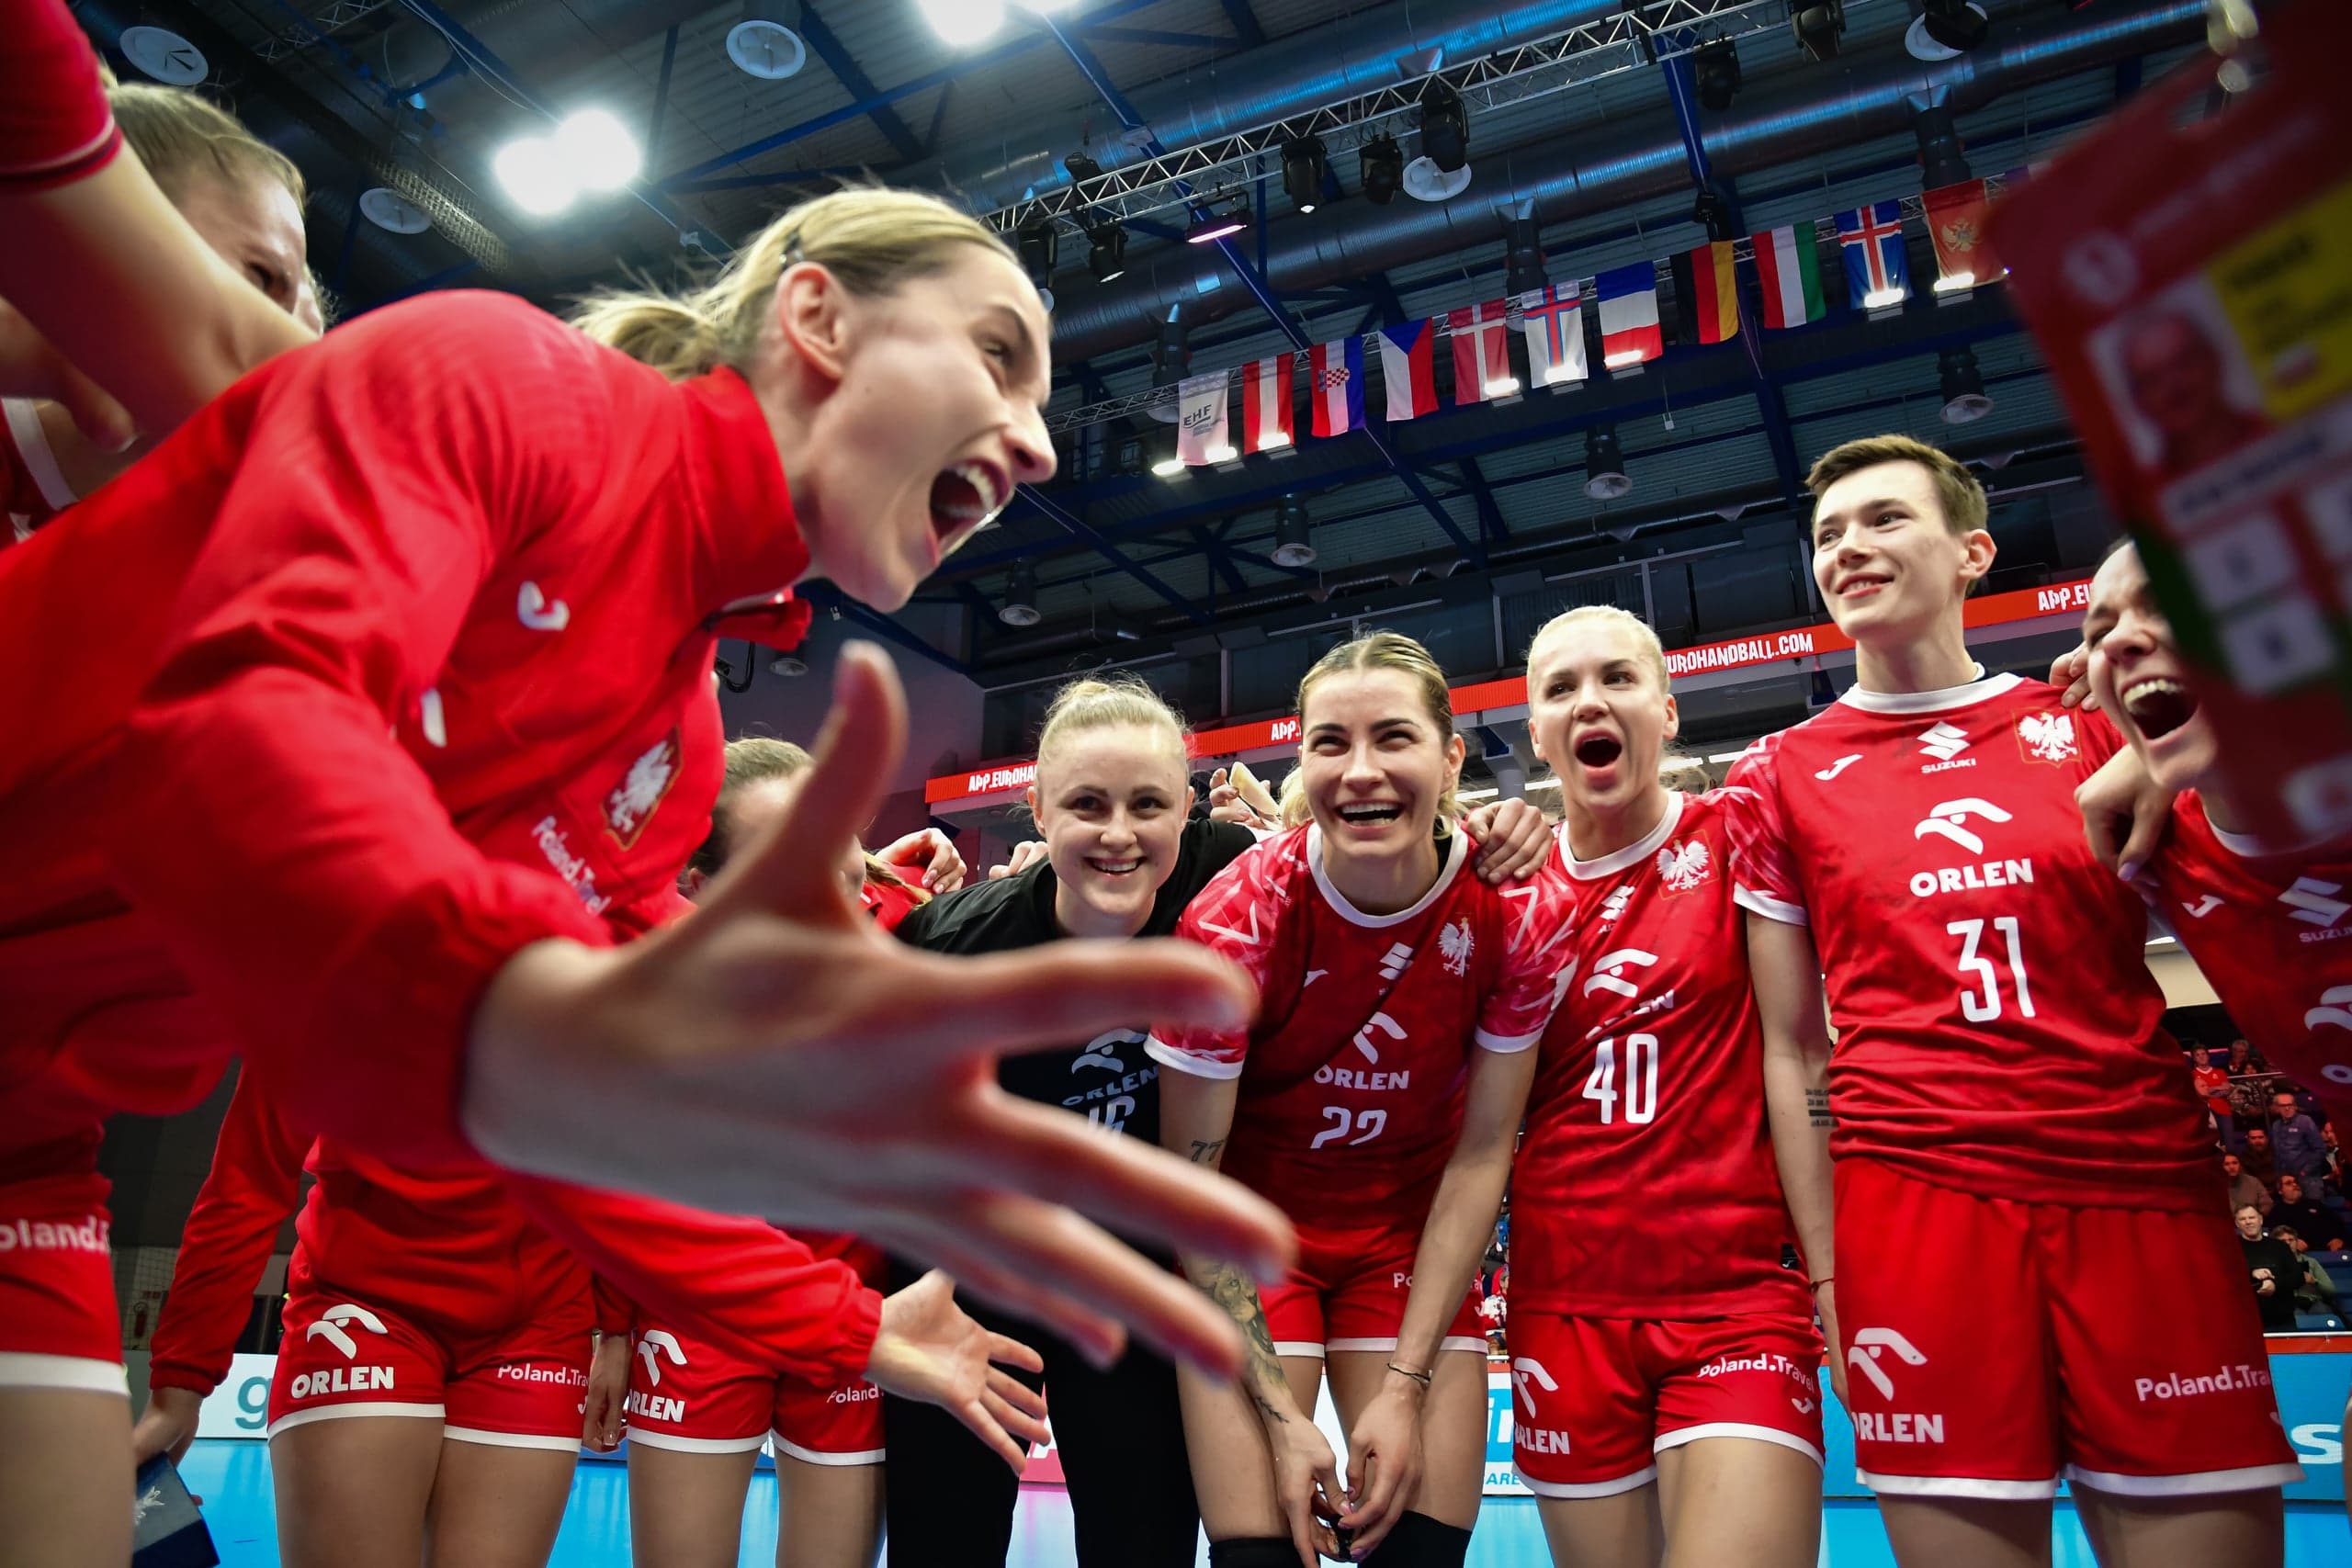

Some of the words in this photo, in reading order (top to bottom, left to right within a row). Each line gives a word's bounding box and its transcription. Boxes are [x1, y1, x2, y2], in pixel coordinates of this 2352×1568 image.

[1183, 404, 1212, 425] EHF
[1921, 758, 1976, 773] SUZUKI
[1909, 858, 2034, 897] ORLEN
[1946, 917, 2036, 1022] 31
[1314, 1064, 1409, 1090] ORLEN
[1582, 1033, 1657, 1124] 40
[290, 1366, 395, 1399] ORLEN
[1697, 1353, 1815, 1393] Poland.Travel
[1851, 1412, 1945, 1443] RLEN
